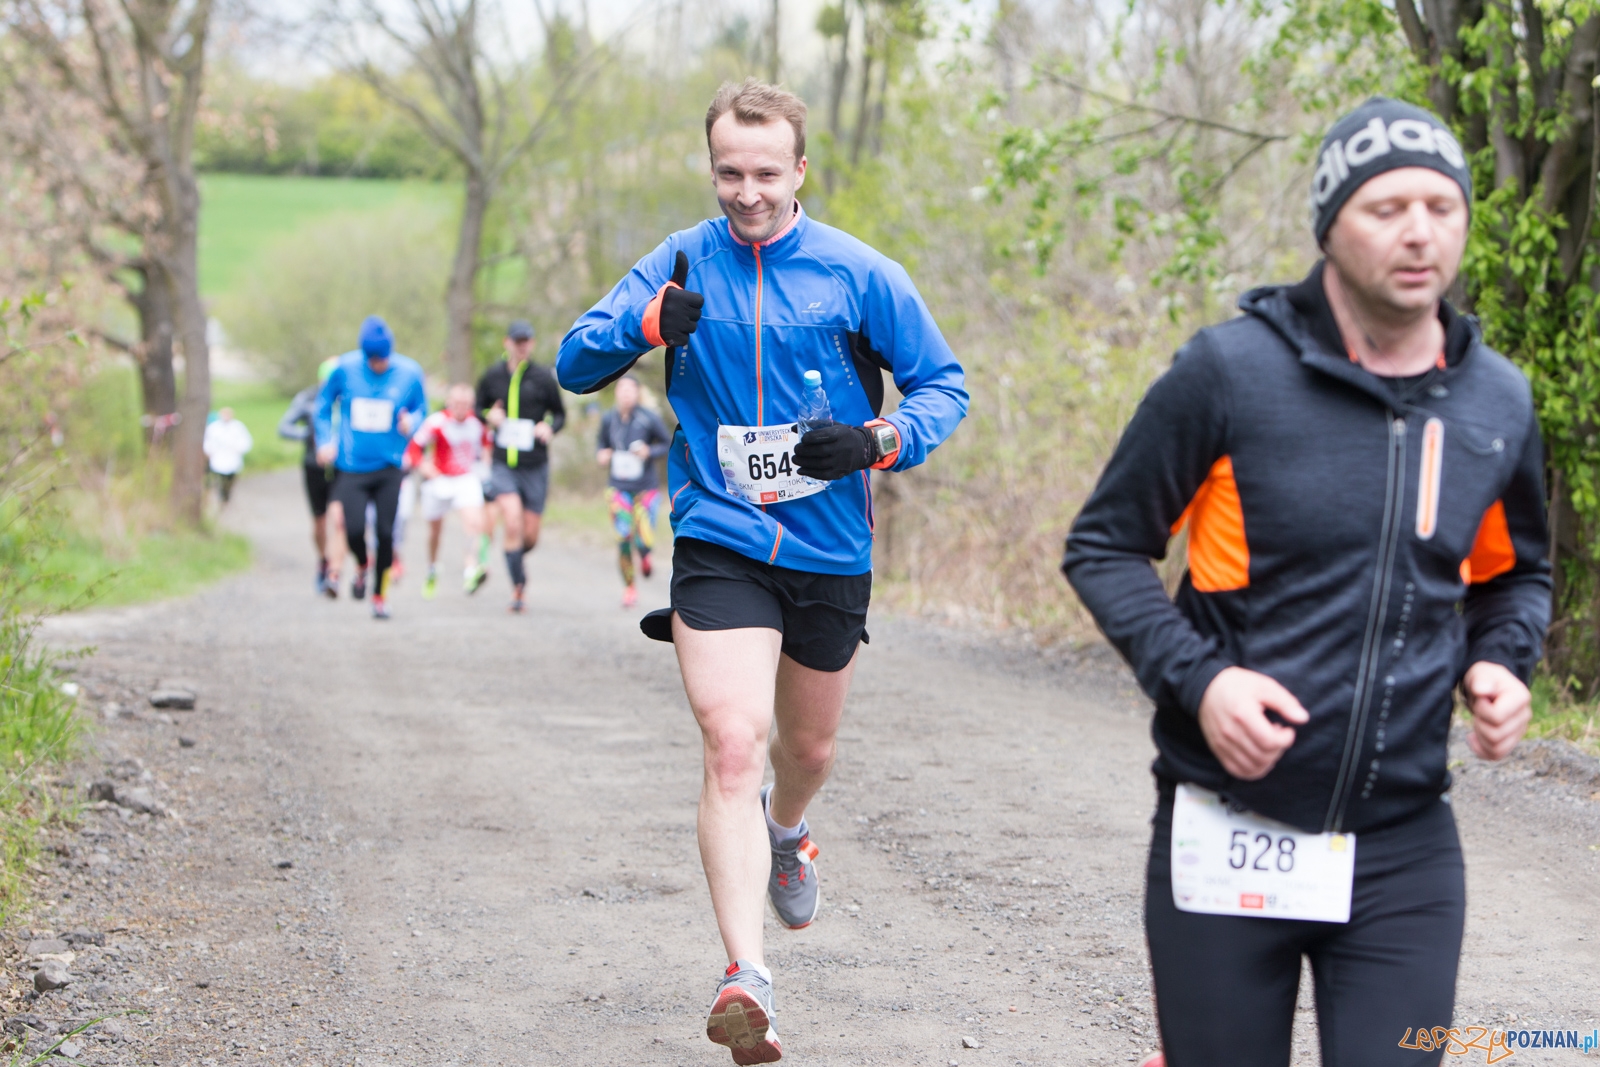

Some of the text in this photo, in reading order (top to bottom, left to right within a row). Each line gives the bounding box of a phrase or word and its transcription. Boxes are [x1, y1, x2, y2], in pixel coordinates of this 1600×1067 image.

[1311, 116, 1465, 206] didas
[757, 428, 792, 437] UNIWERSYTECK
[747, 451, 793, 481] 654
[738, 482, 754, 491] 5KM
[1228, 829, 1297, 874] 528
